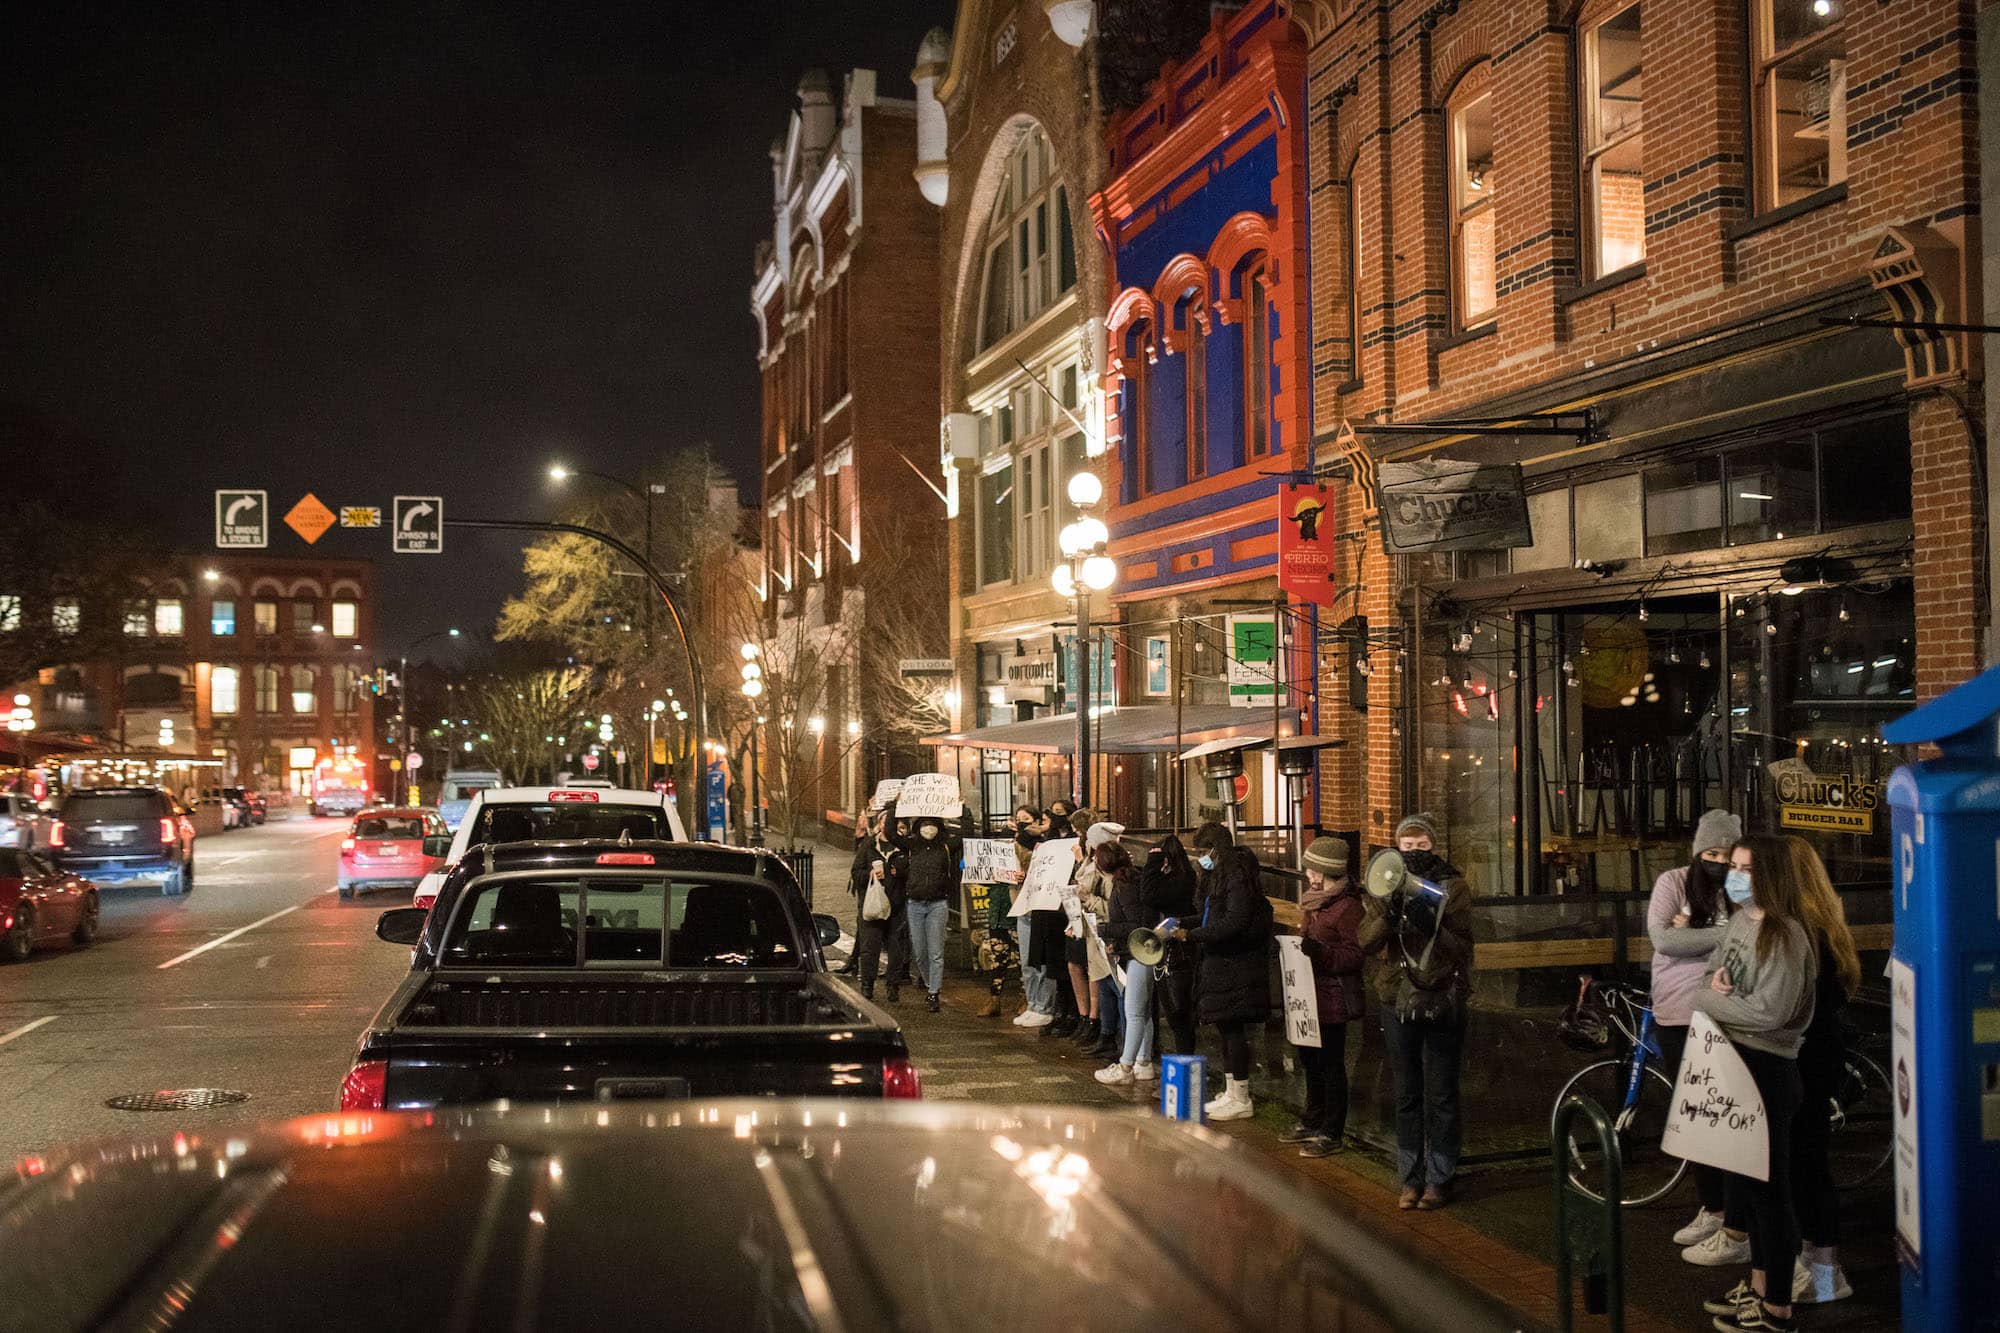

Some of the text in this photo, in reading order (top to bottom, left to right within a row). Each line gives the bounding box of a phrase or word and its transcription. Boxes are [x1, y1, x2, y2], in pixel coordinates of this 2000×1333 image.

[348, 513, 372, 521] NEW
[224, 526, 259, 534] TO BRIDGE
[409, 541, 426, 549] EAST
[1287, 553, 1328, 564] PERRO
[911, 776, 925, 785] SHE
[1776, 771, 1877, 809] Chuck's
[1788, 813, 1864, 826] BURGER BAR
[977, 840, 993, 856] CAN
